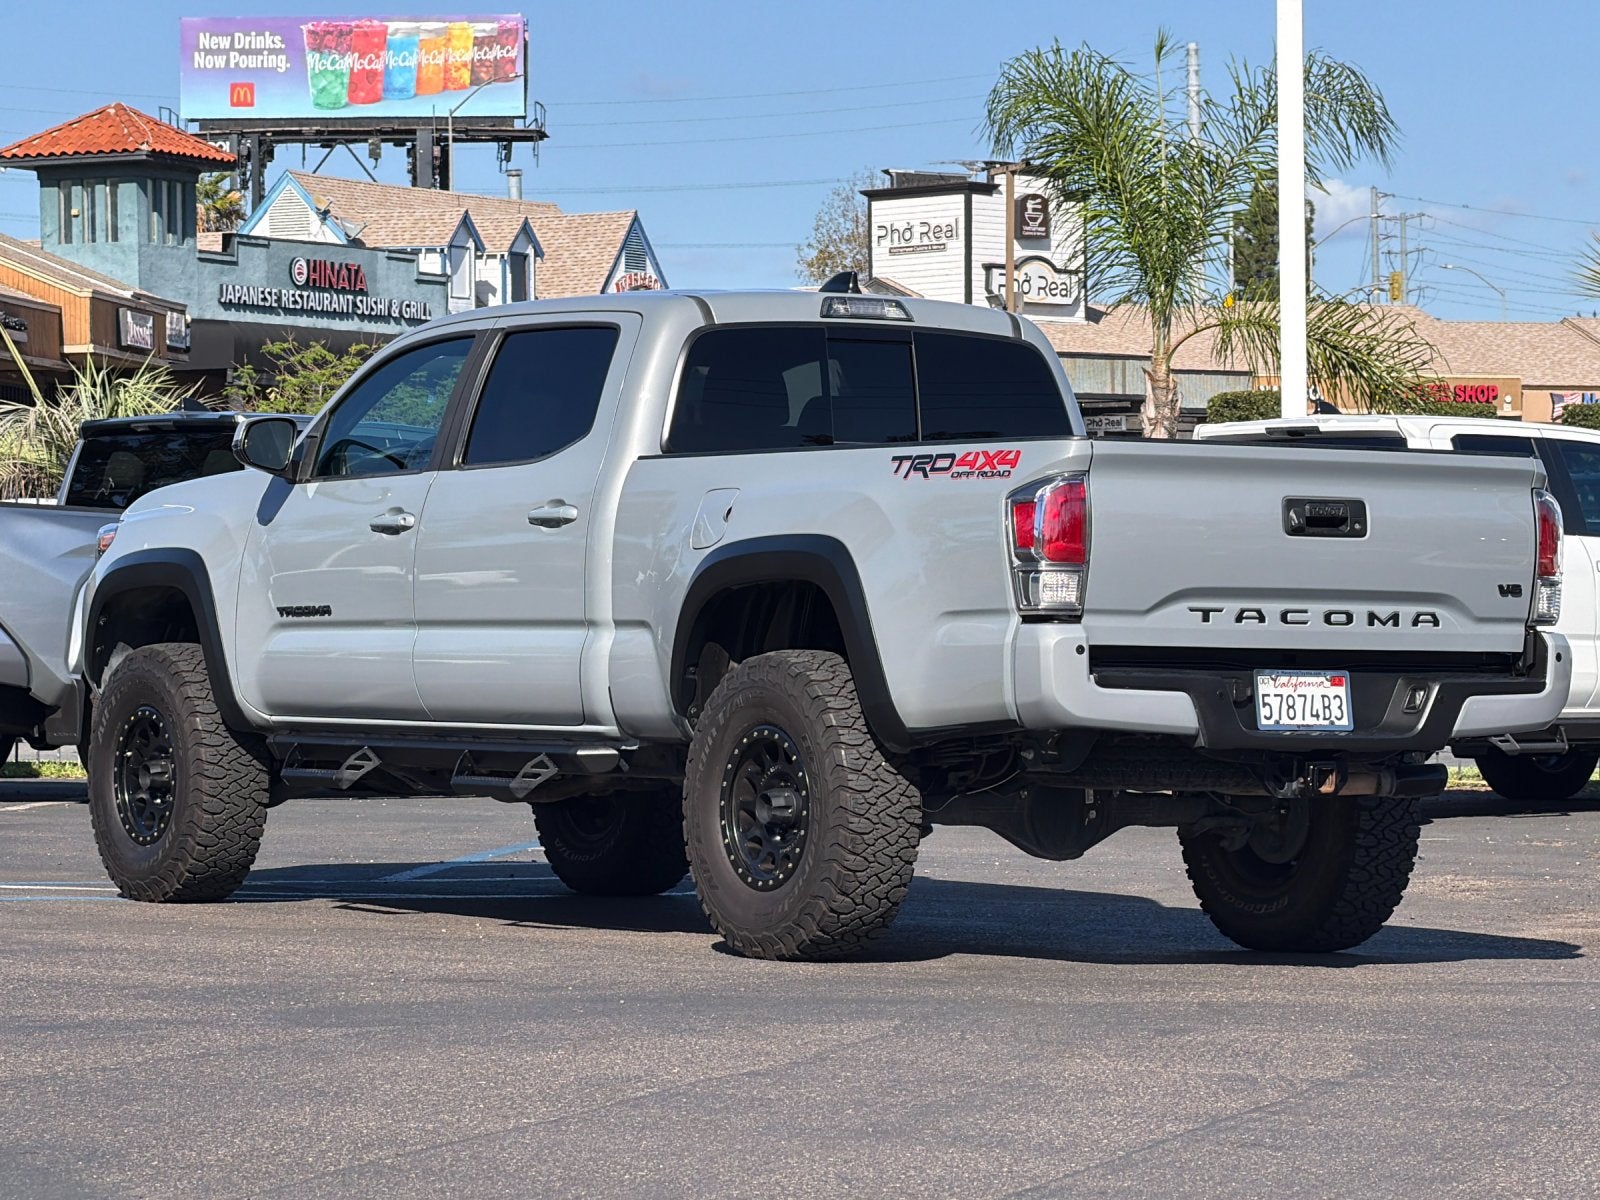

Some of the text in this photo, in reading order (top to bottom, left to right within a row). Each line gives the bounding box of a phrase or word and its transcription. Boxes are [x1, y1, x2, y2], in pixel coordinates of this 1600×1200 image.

[200, 32, 285, 49] New Drinks.
[194, 51, 291, 72] Now Pouring.
[920, 217, 960, 242] Real
[308, 259, 368, 291] HINATA
[1037, 275, 1072, 298] Real
[220, 284, 432, 321] JAPANESE RESTAURANT SUSHI & GRILL
[1454, 384, 1498, 403] SHOP
[891, 453, 956, 479] TRD
[977, 470, 1011, 478] ROAD
[1497, 583, 1523, 598] V6
[1188, 606, 1442, 628] TACOMA
[1273, 675, 1331, 692] California
[1261, 693, 1344, 721] 57874B3
